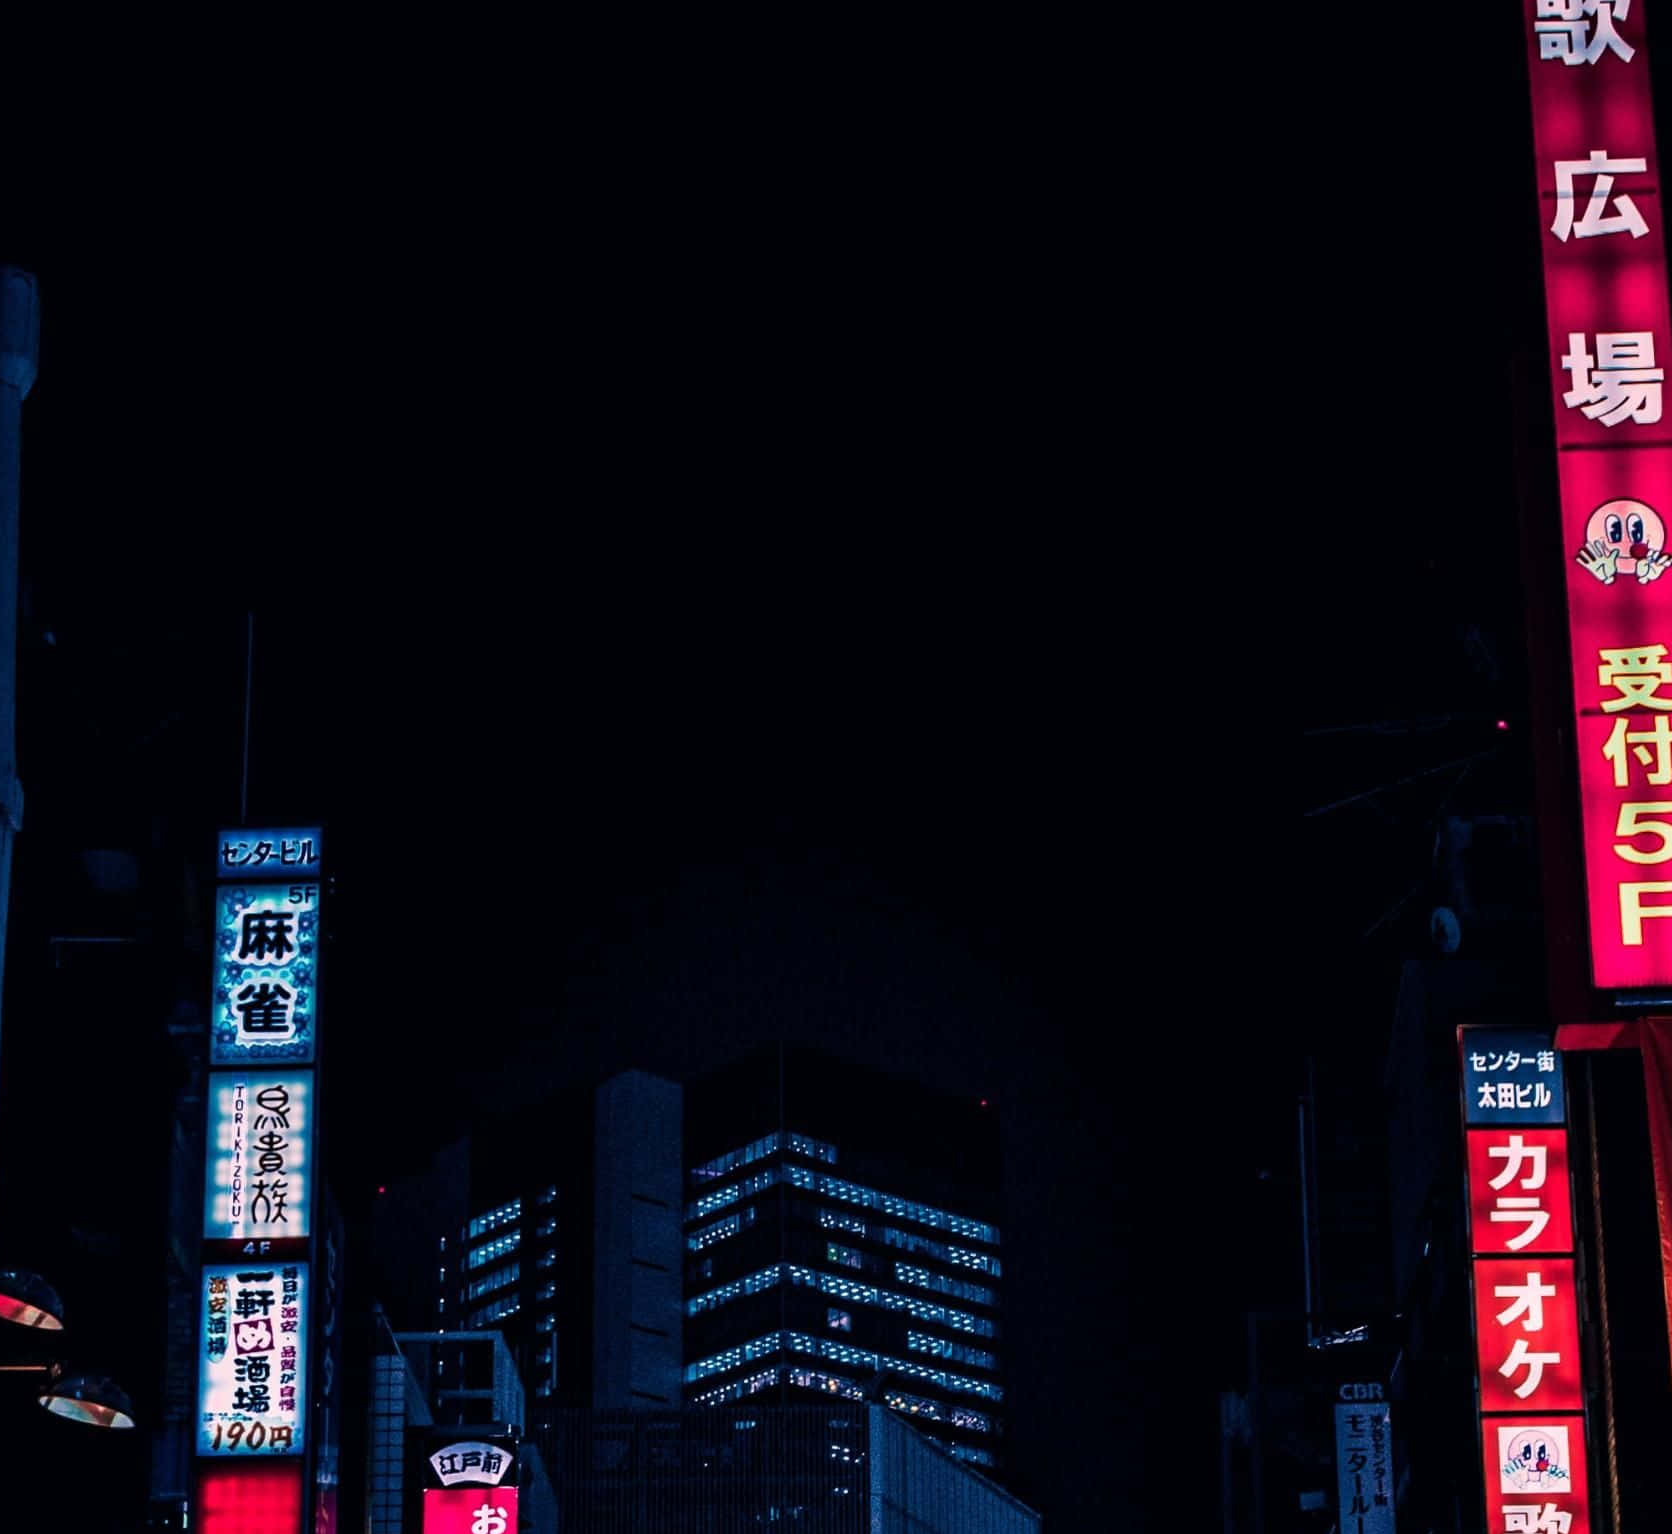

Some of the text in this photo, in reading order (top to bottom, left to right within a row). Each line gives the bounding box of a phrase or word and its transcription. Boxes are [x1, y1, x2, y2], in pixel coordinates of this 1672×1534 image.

[221, 839, 318, 865] センタービル
[288, 886, 317, 904] 5F
[237, 910, 294, 1033] 麻雀
[1470, 1050, 1555, 1074] センター街
[1477, 1083, 1552, 1109] 太田ビル
[251, 1085, 292, 1224] 鳥貴族
[243, 1242, 271, 1255] 4F
[1487, 1135, 1560, 1400] カラオケ
[232, 1271, 276, 1413] 一軒め酒場
[212, 1421, 293, 1450] 190円
[439, 1450, 503, 1476] 江戸前
